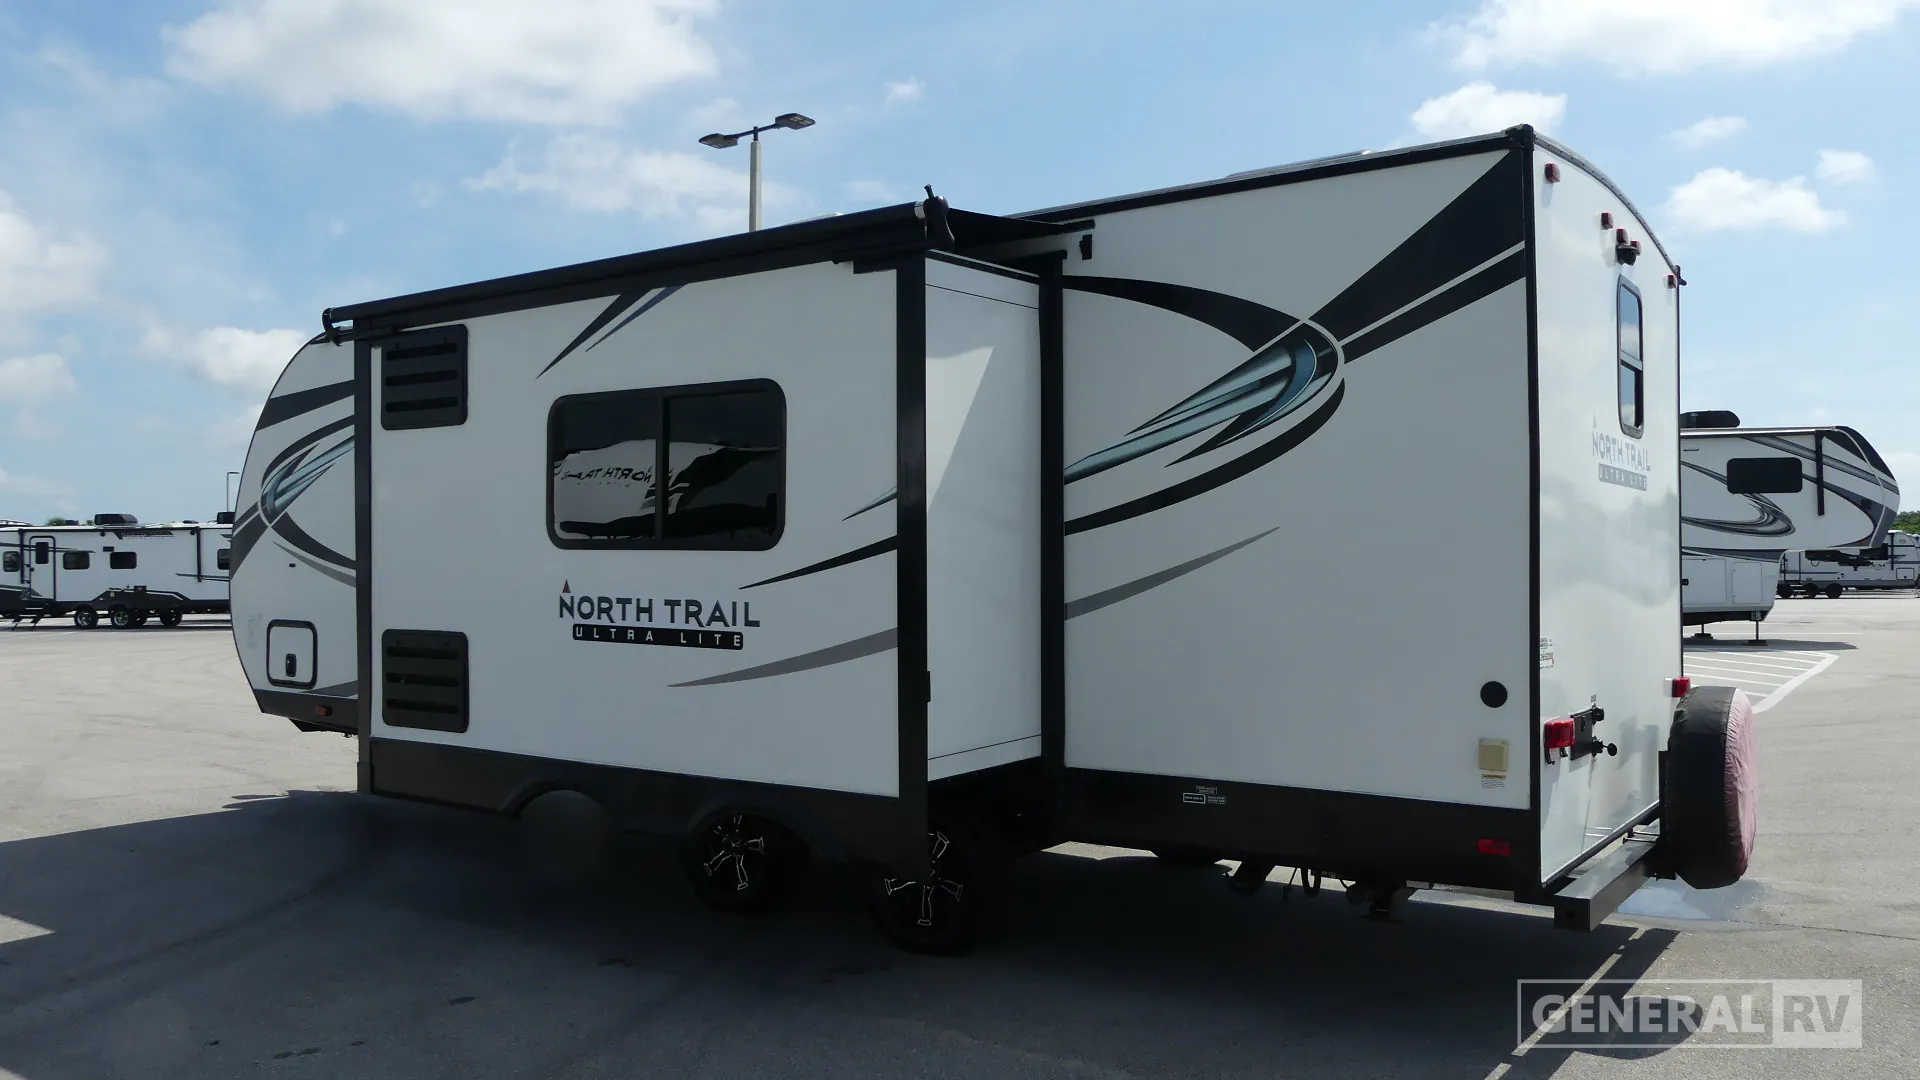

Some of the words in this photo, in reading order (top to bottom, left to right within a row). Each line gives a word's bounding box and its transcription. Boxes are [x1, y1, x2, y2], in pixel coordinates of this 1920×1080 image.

[1592, 431, 1624, 464] NORTH
[1625, 442, 1651, 472] TRAIL
[559, 595, 653, 624] NORTH
[664, 599, 760, 628] TRAIL
[575, 626, 654, 642] ULTRA
[680, 631, 741, 646] LITE
